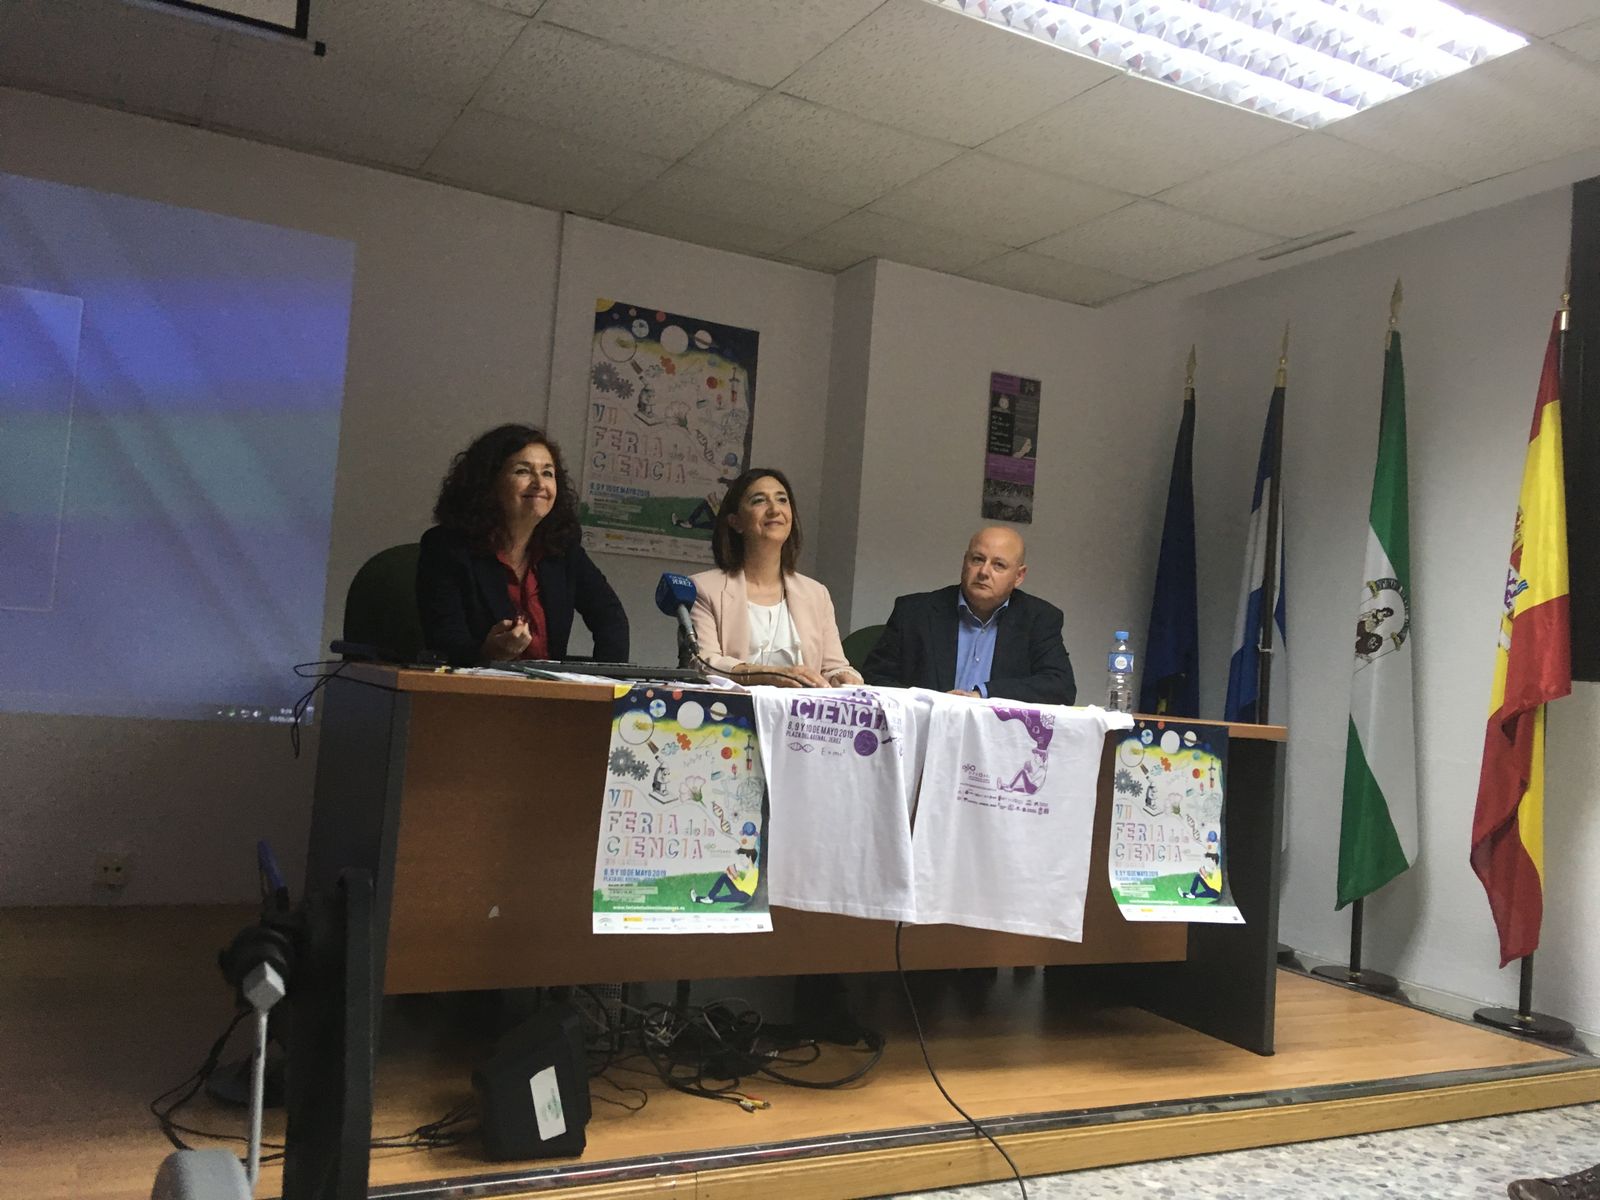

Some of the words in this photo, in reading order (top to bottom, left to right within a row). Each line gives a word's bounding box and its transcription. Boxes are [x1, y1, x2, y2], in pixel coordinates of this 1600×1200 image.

[592, 425, 663, 458] FERIA
[592, 451, 686, 484] CIENCIA
[801, 723, 806, 732] Y
[813, 725, 820, 733] DE
[820, 726, 838, 737] MAYO
[840, 728, 854, 739] 2019
[607, 810, 679, 836] FERIA
[1115, 822, 1165, 842] FERIA
[606, 835, 703, 859] CIENCIA
[1114, 843, 1183, 863] CIENCIA
[635, 869, 652, 877] MAYO
